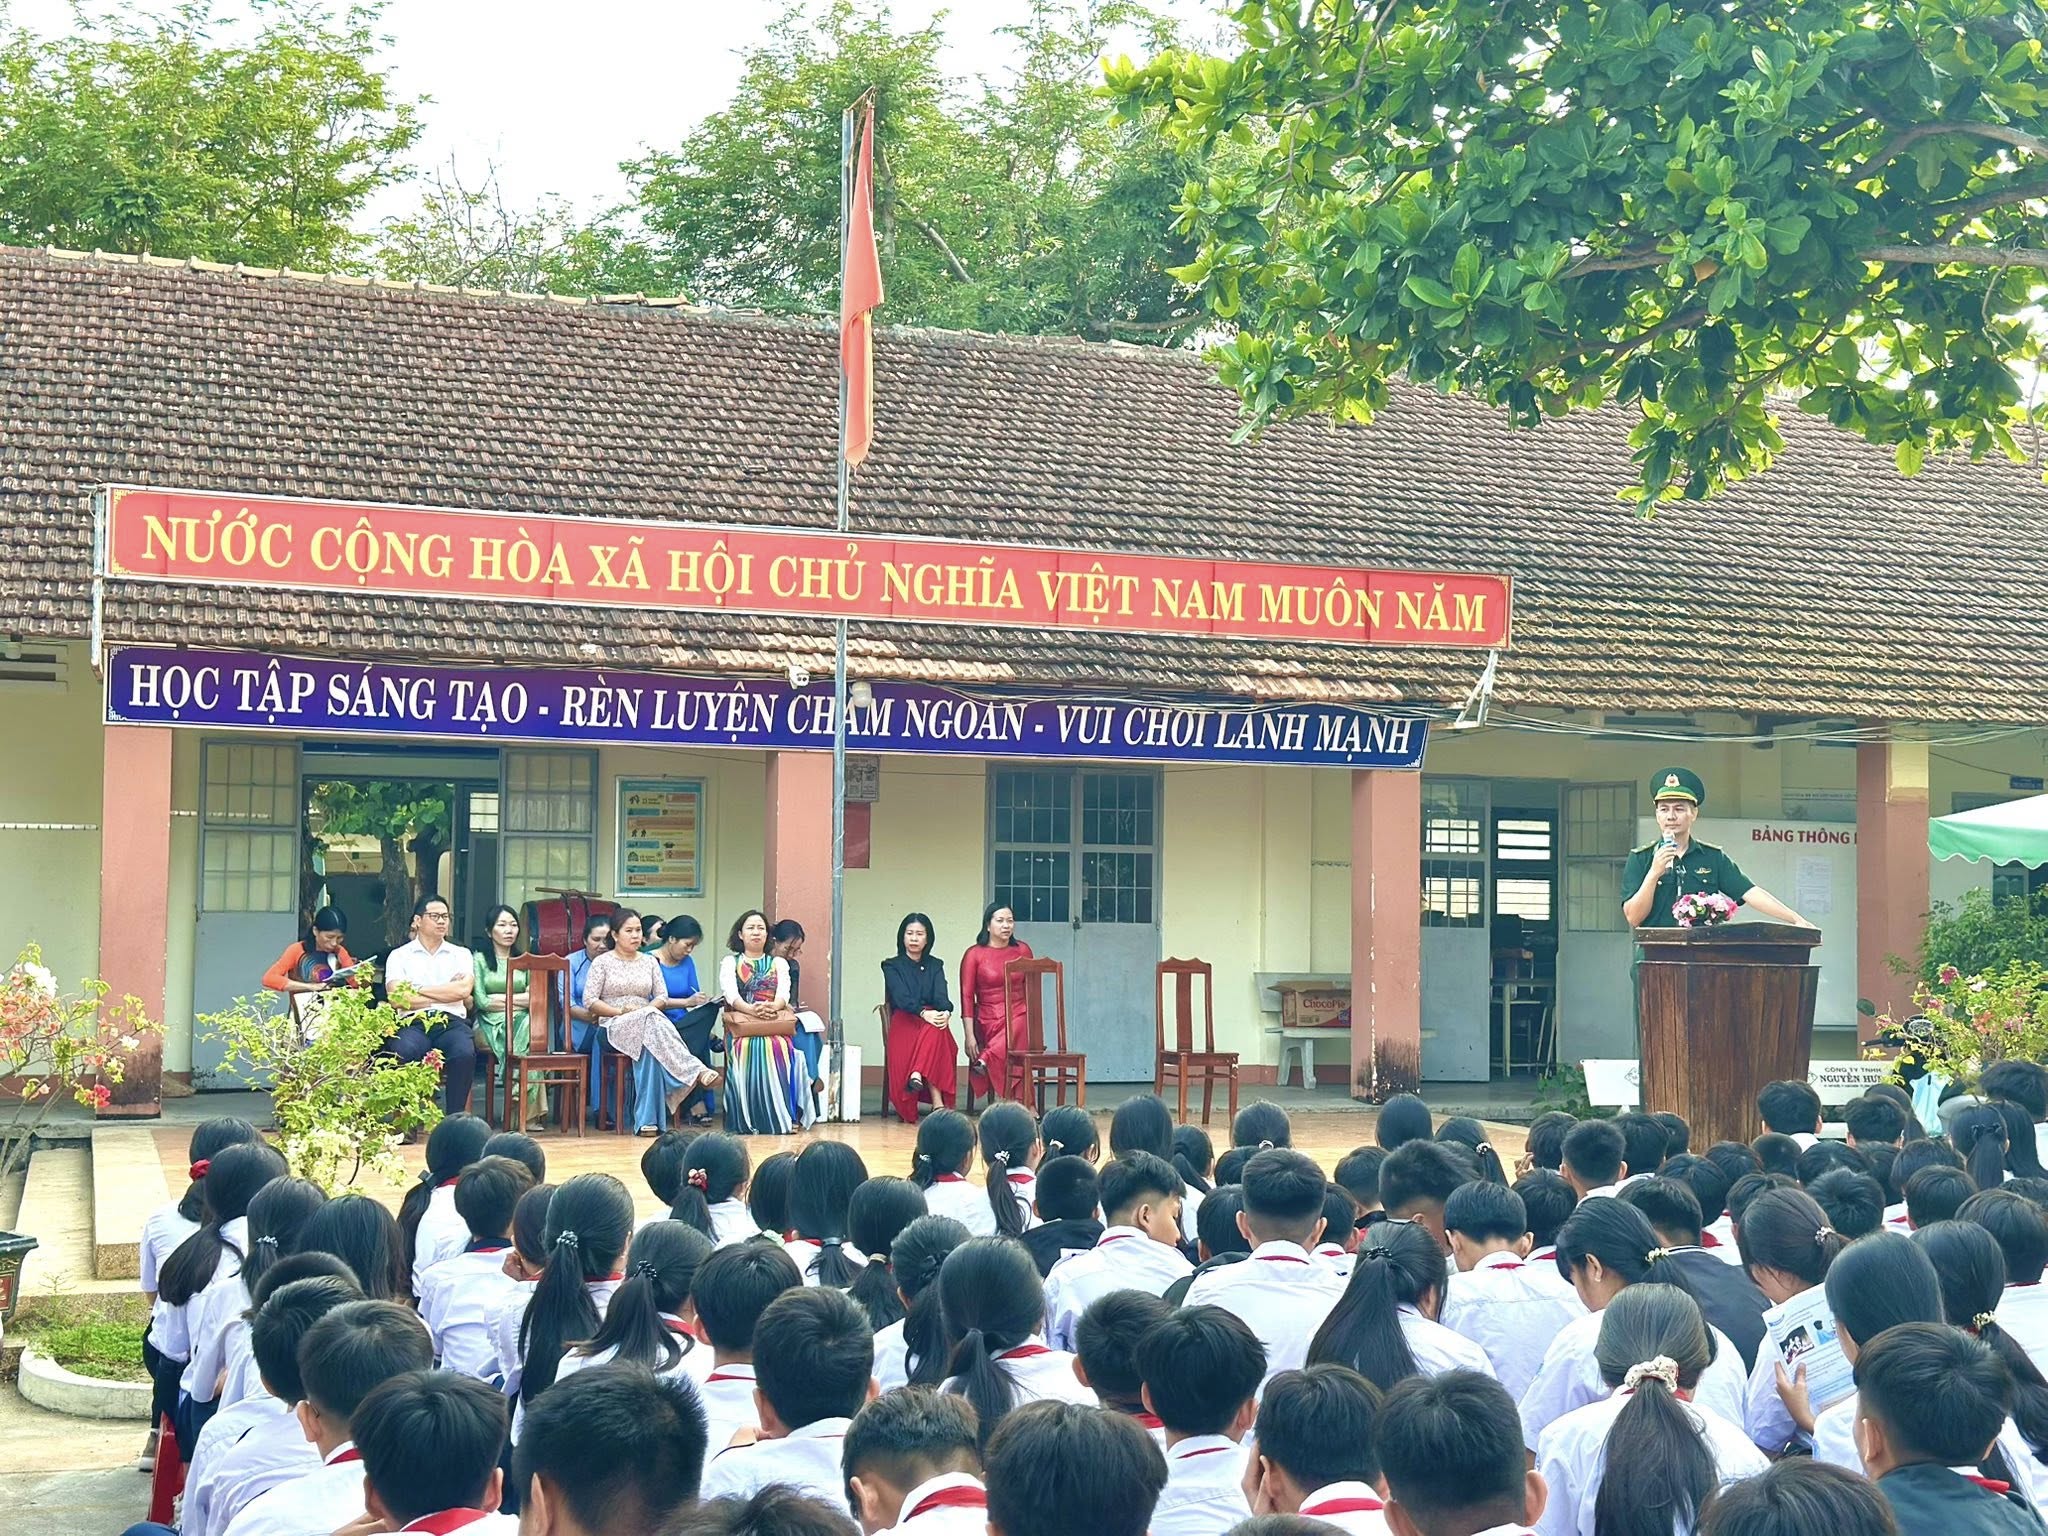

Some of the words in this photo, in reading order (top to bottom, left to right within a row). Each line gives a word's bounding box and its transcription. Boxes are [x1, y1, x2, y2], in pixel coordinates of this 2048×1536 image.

[140, 507, 293, 568] NƯỚC
[310, 517, 455, 583] CỘNG
[467, 524, 576, 586] HÒA
[586, 535, 652, 590] XÃ
[666, 540, 755, 602] HỘI
[769, 543, 867, 601] CHỦ
[880, 555, 1024, 611] NGHĨA
[1036, 562, 1139, 623] VIỆT
[1151, 578, 1246, 623] NAM
[1258, 576, 1384, 628] MUÔN
[1395, 582, 1487, 632] NĂM
[129, 665, 219, 718] HỌC
[233, 658, 315, 724] TẬP
[328, 664, 436, 722] SÁNG
[449, 681, 527, 733] TẠO
[560, 674, 643, 728] RÈN
[651, 681, 778, 743] LUYỆN
[1057, 705, 1115, 744] VUI
[1313, 714, 1412, 762] MẠNH
[1752, 825, 1794, 843] BẢNG
[1798, 827, 1850, 844] THÔNG
